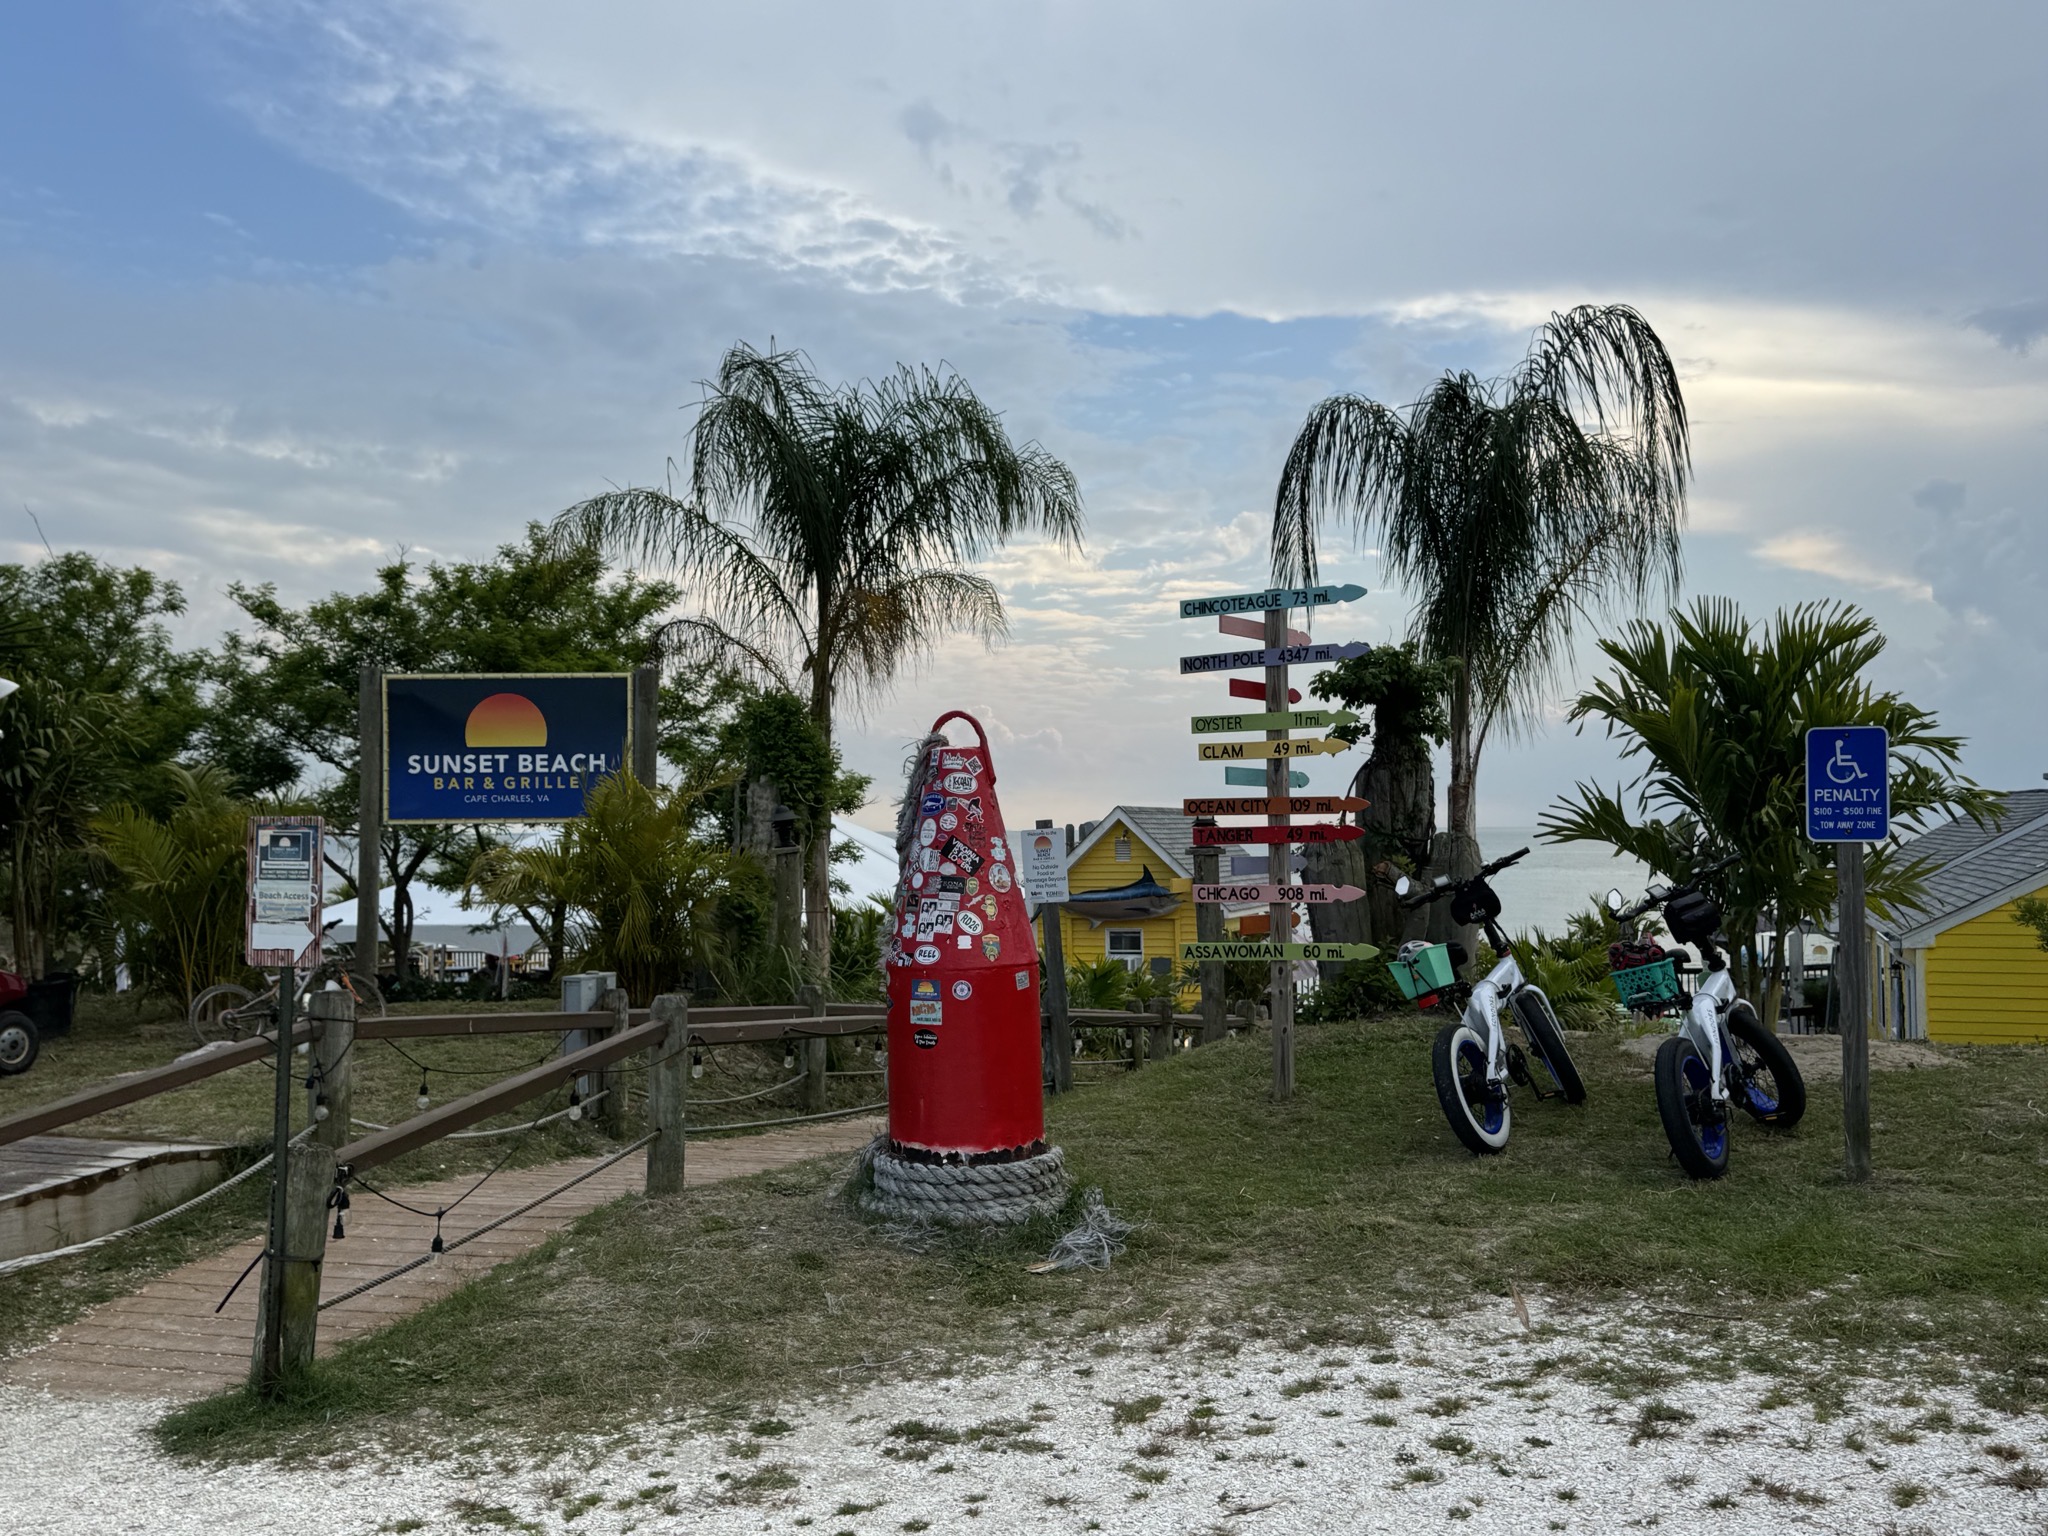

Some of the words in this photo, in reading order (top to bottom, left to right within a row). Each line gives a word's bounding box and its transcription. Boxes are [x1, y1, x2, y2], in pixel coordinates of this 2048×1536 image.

[1184, 593, 1282, 616] CHINCOTEAGUE
[1292, 592, 1308, 605] 73
[1313, 592, 1331, 603] mi.
[1184, 655, 1228, 671] NORTH
[1233, 651, 1266, 666] POLE
[1278, 648, 1309, 662] 4347
[1315, 648, 1333, 660] mi.
[1195, 716, 1242, 732] OYSTER
[1294, 713, 1303, 726] 11
[1305, 713, 1322, 726] mi.
[1203, 744, 1244, 758] CLAM
[1273, 742, 1290, 755] 49
[1296, 741, 1313, 754] mi.
[408, 754, 509, 774] SUNSET
[518, 753, 606, 773] BEACH
[434, 777, 474, 790] BAR
[483, 777, 495, 790] &
[504, 776, 580, 789] GRILLE
[464, 794, 487, 803] CAPE
[491, 794, 534, 803] CHARLES,
[537, 794, 550, 802] VA
[1815, 788, 1880, 802] PENALTY
[1188, 800, 1236, 814] OCEAN
[1241, 799, 1271, 812] CITY
[1289, 799, 1310, 812] 109
[1316, 800, 1334, 812] mi.
[1813, 807, 1832, 815] $100
[1843, 807, 1864, 815] $500
[1866, 807, 1882, 815] FINE
[1820, 821, 1835, 829] TOW
[1836, 821, 1854, 829] AWAY
[1857, 820, 1876, 828] ZONE
[1197, 829, 1253, 843] TANGIER
[1286, 827, 1303, 840] 49
[1309, 827, 1327, 840] mi.
[952, 838, 980, 864] VIRGINIA
[958, 851, 972, 865] FOR
[259, 891, 282, 899] Beach
[283, 891, 309, 900] Access
[1197, 887, 1260, 900] CHICAGO
[1278, 887, 1304, 900] 908
[1309, 888, 1328, 900] mi.
[960, 914, 978, 932] RD26
[918, 949, 936, 958] REEL
[1184, 944, 1284, 959] ASSAWOMAN
[1303, 945, 1320, 959] 60
[1327, 945, 1345, 958] mi.
